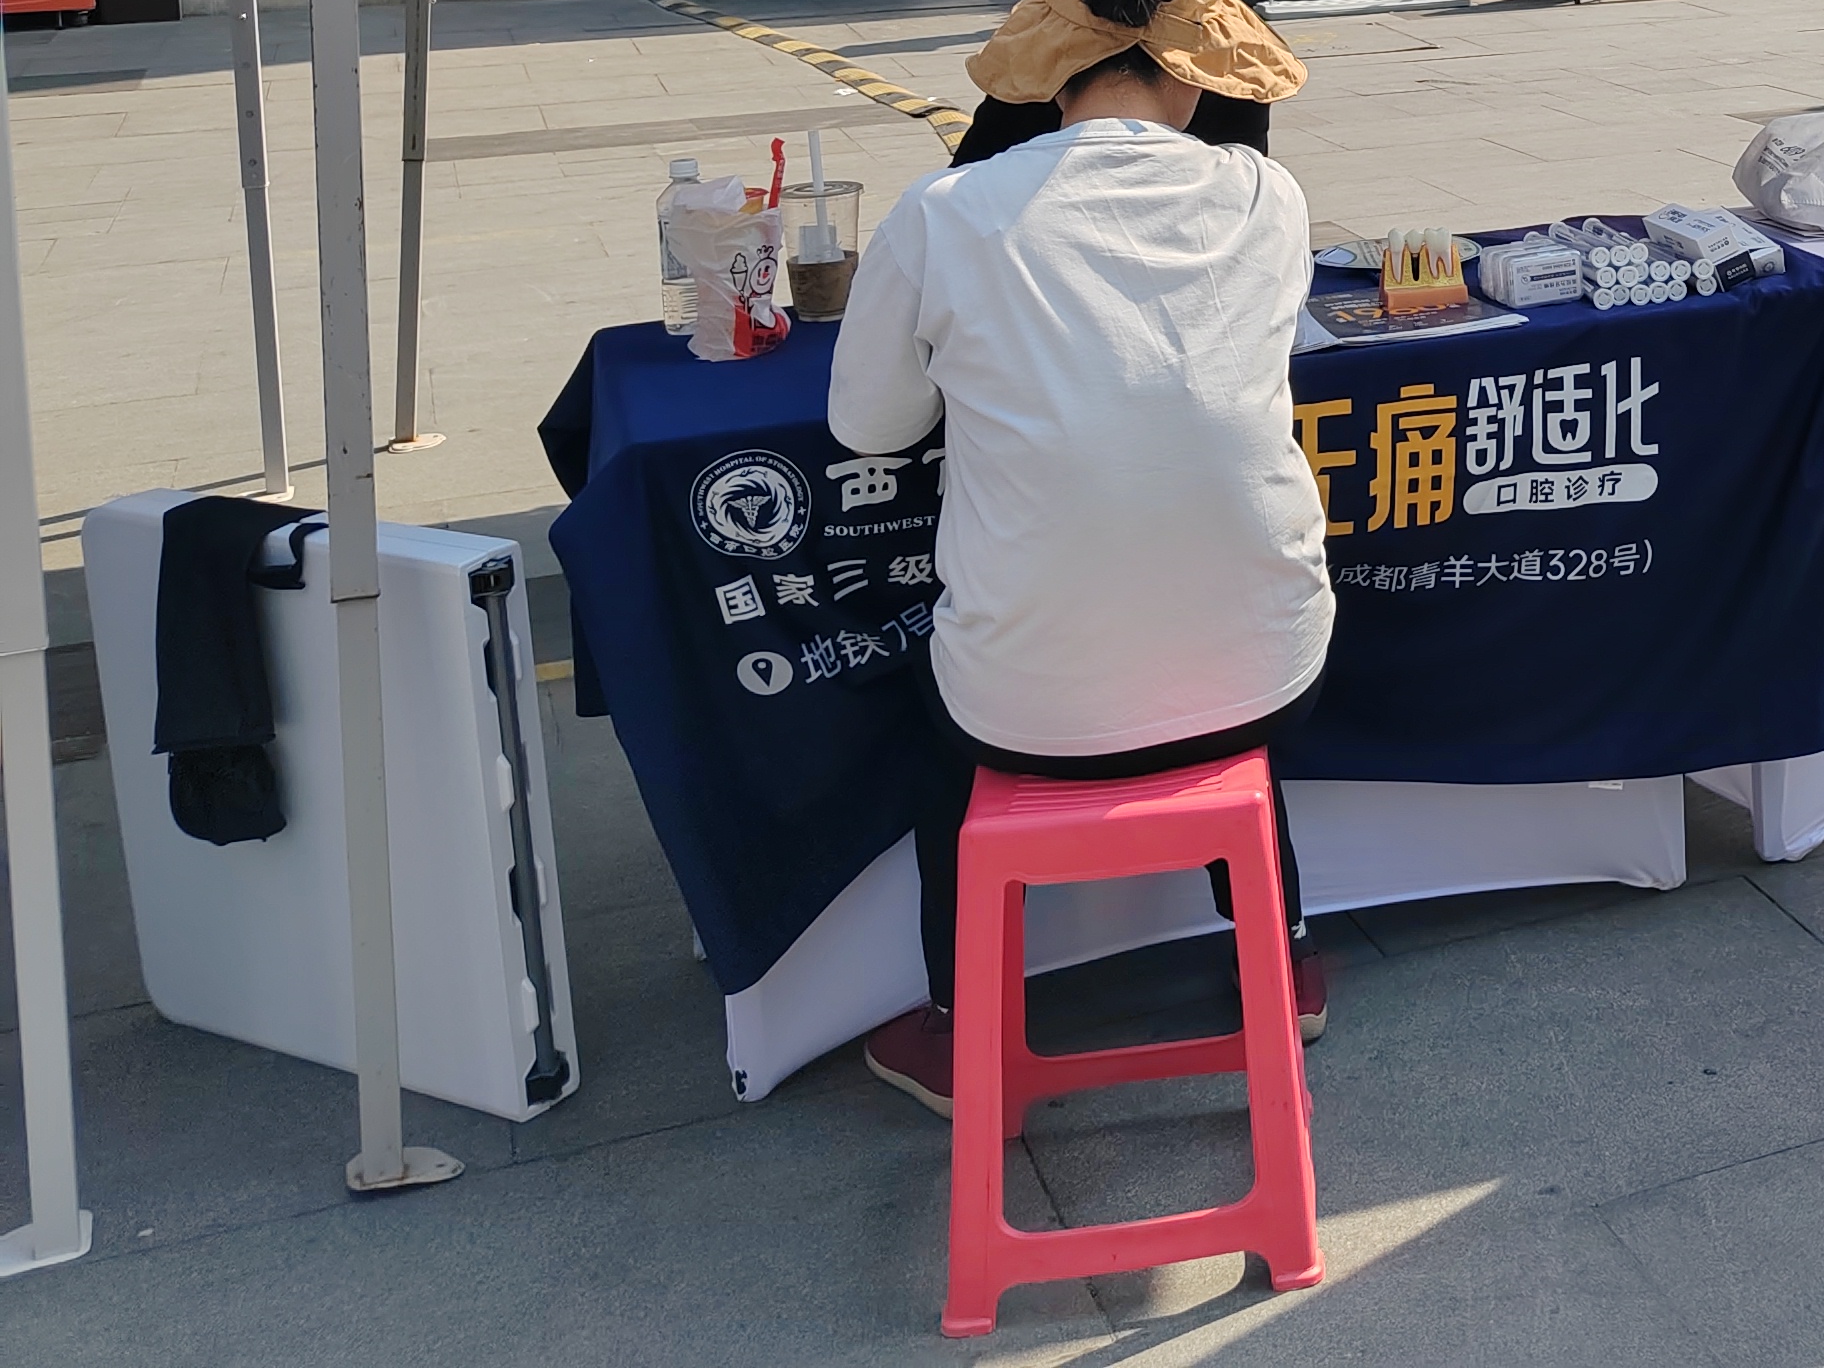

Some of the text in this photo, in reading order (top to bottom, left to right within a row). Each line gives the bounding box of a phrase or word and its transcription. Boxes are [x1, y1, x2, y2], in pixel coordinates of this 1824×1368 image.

[1464, 356, 1660, 476] 舒适化
[1496, 470, 1624, 508] 口腔诊疗
[823, 515, 937, 538] SOUTHWEST
[715, 553, 935, 626] 国家三级
[800, 601, 936, 684] 地铁7号
